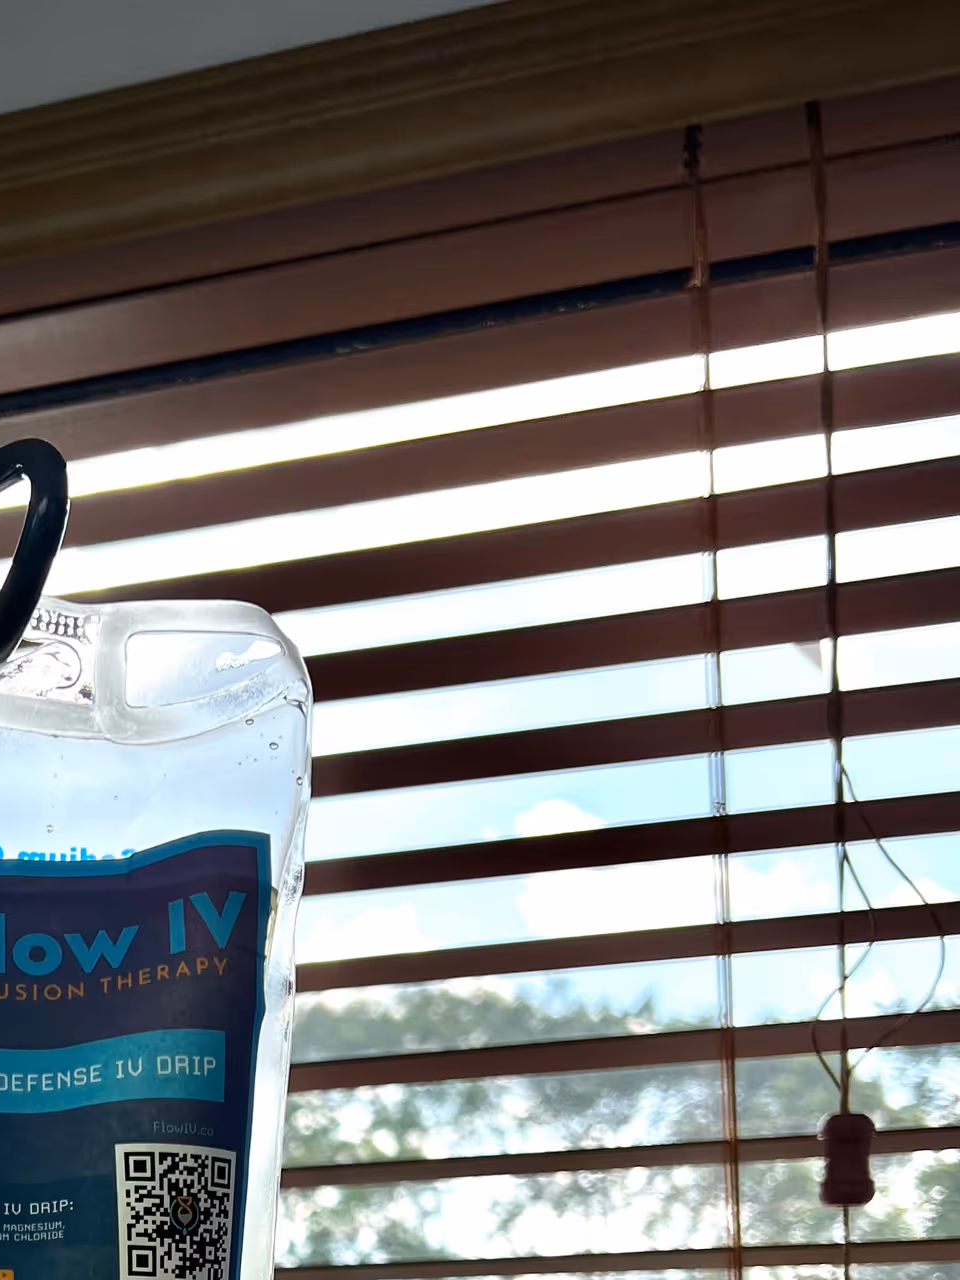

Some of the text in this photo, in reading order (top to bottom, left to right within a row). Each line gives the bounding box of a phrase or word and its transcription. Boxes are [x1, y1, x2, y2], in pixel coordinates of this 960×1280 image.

[168, 891, 248, 956] IV
[100, 957, 229, 995] THERAPY
[114, 1058, 144, 1080] IV
[156, 1055, 218, 1077] DRIP
[153, 1120, 215, 1137] FlowIV.co
[3, 1202, 22, 1216] IV
[29, 1199, 74, 1216] DRIP:
[3, 1221, 66, 1233] MAGNESIUM,
[13, 1230, 65, 1242] CHLORIDE
